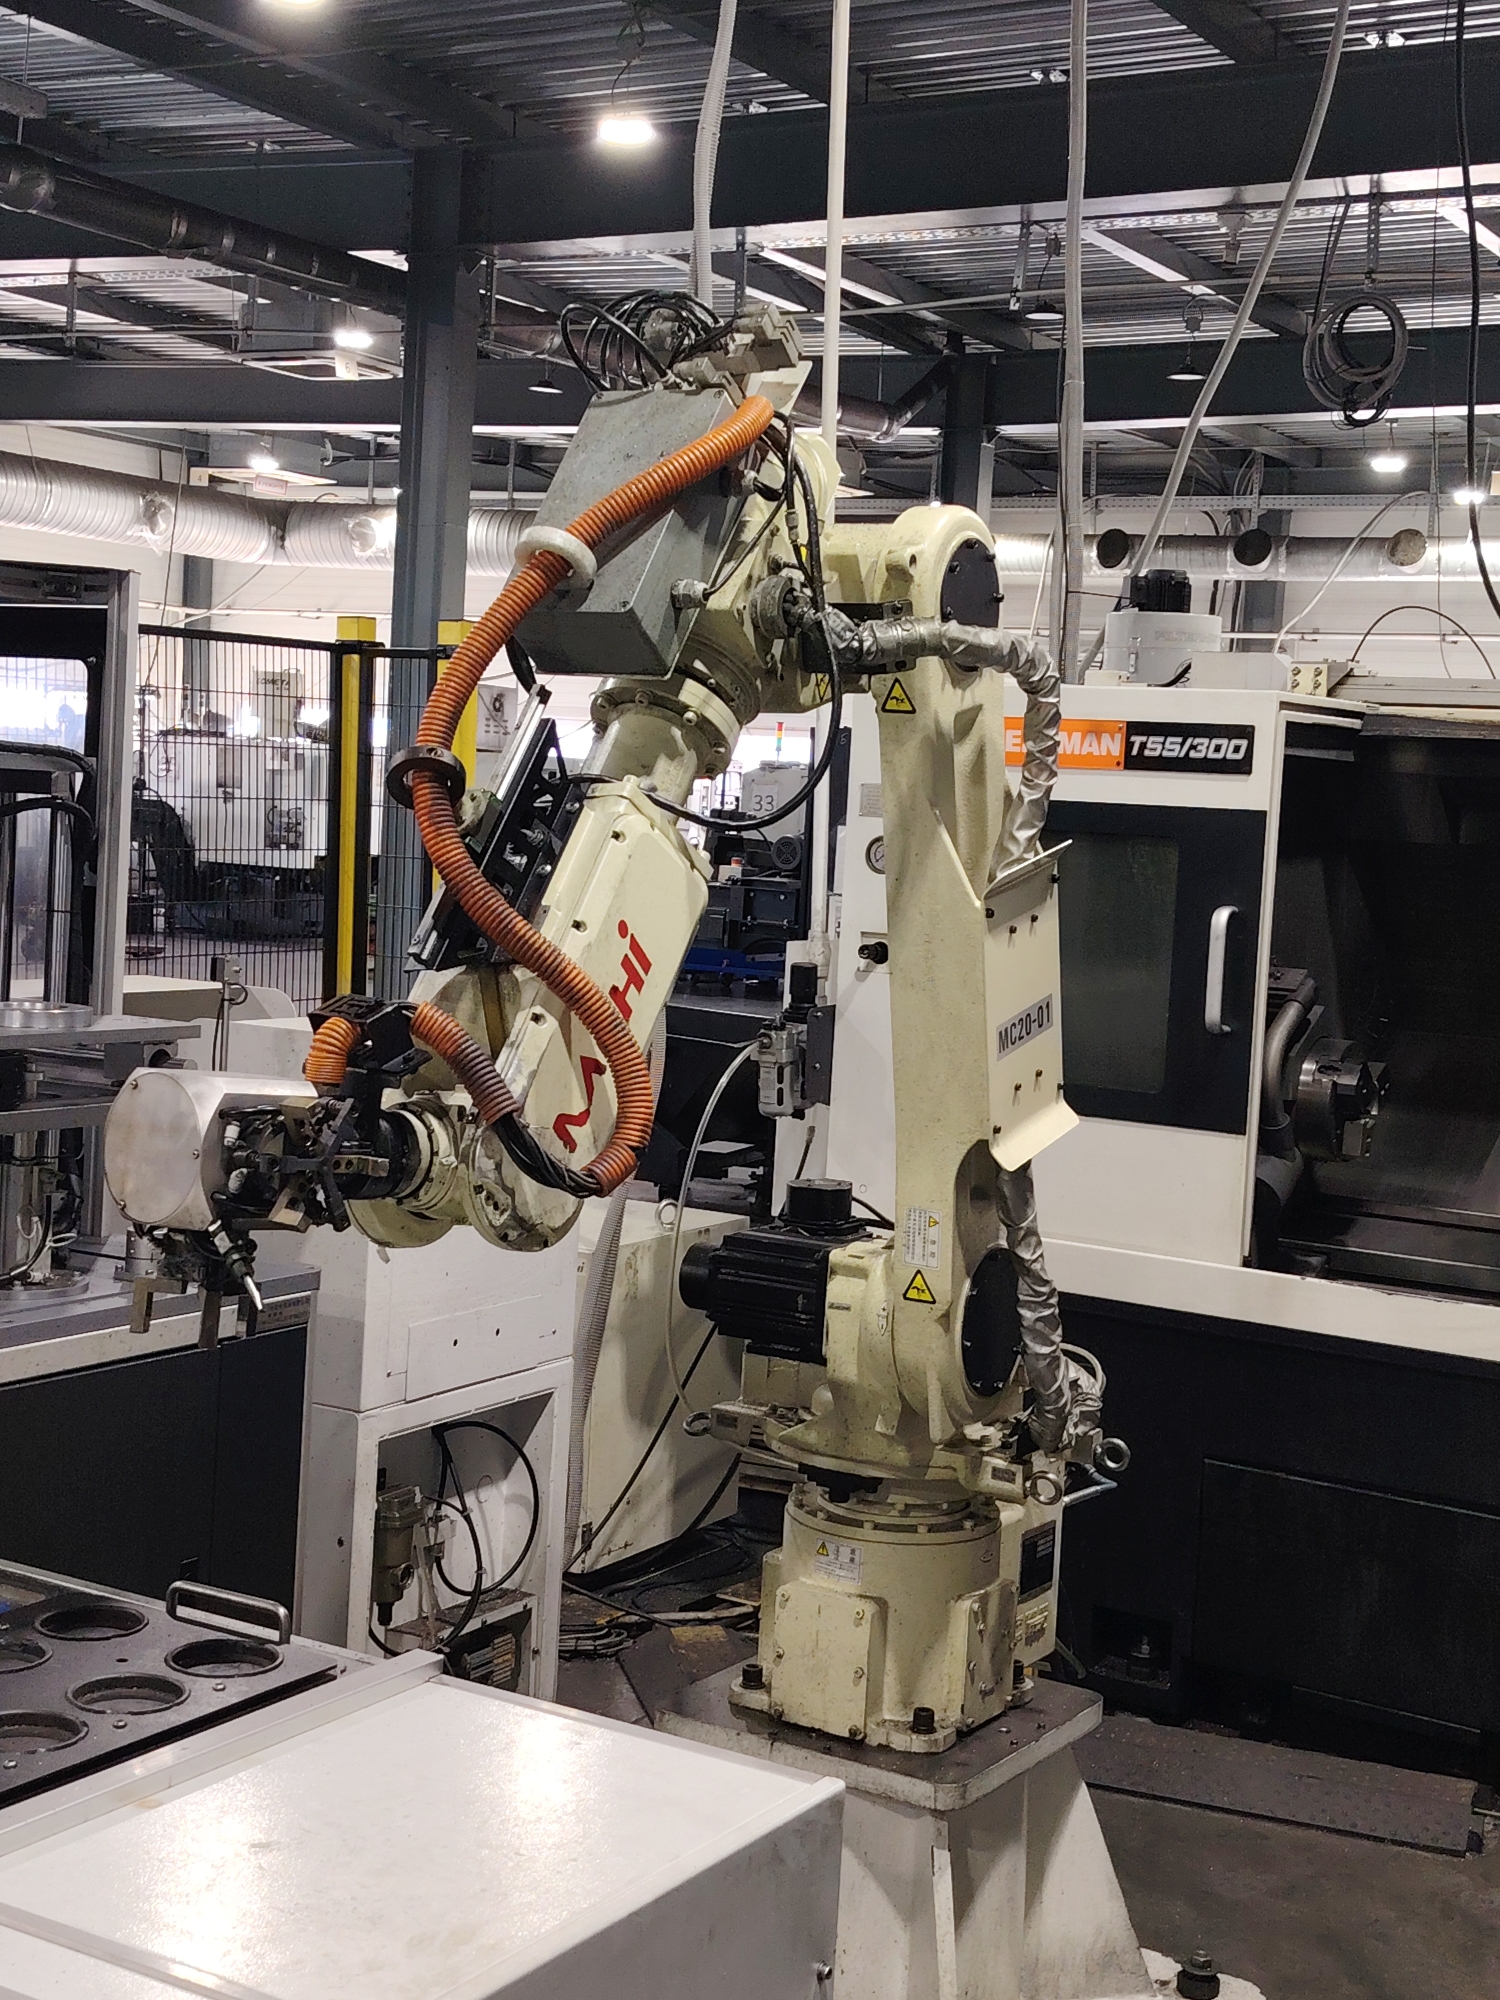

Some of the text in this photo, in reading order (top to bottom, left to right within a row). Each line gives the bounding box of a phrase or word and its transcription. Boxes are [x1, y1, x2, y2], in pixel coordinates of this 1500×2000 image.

[1004, 729, 1122, 757] EMAN
[753, 794, 775, 812] 33
[998, 1000, 1051, 1054] MC20-01
